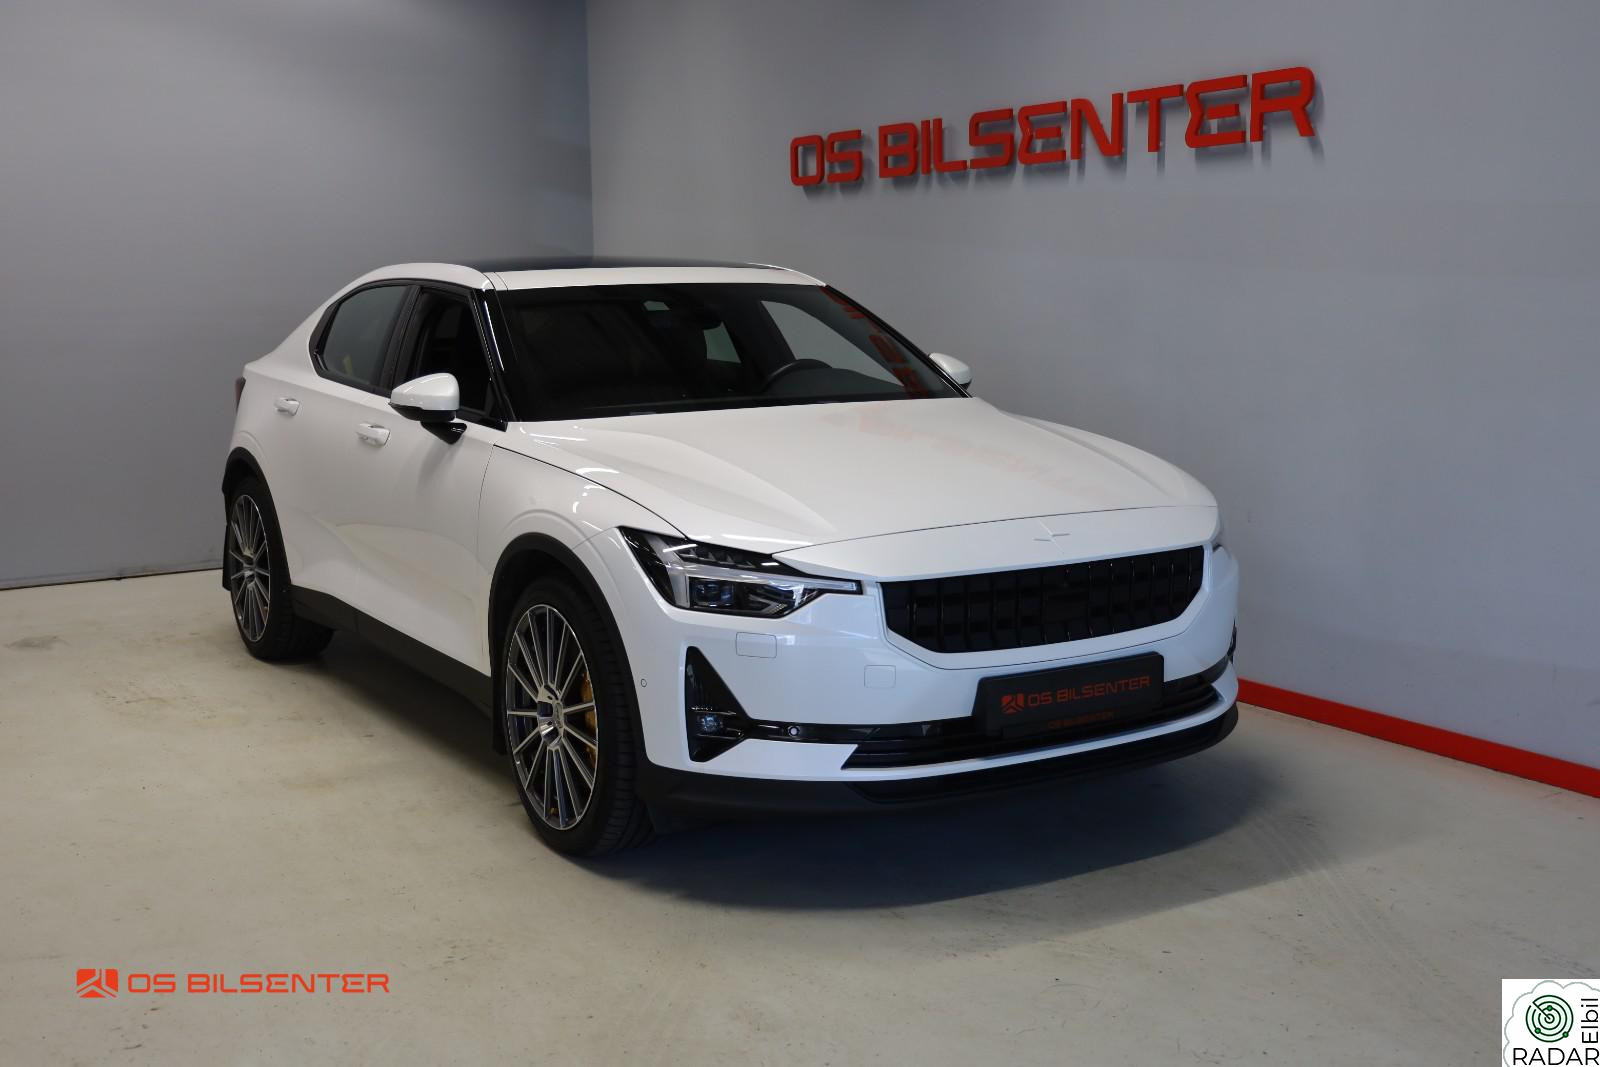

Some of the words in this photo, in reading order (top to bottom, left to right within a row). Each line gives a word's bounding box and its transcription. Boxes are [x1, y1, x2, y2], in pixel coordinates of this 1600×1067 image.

[790, 129, 863, 187] OS
[878, 66, 1316, 179] BILSENTER
[1027, 691, 1053, 708] OS
[1056, 675, 1152, 703] BILSENTER
